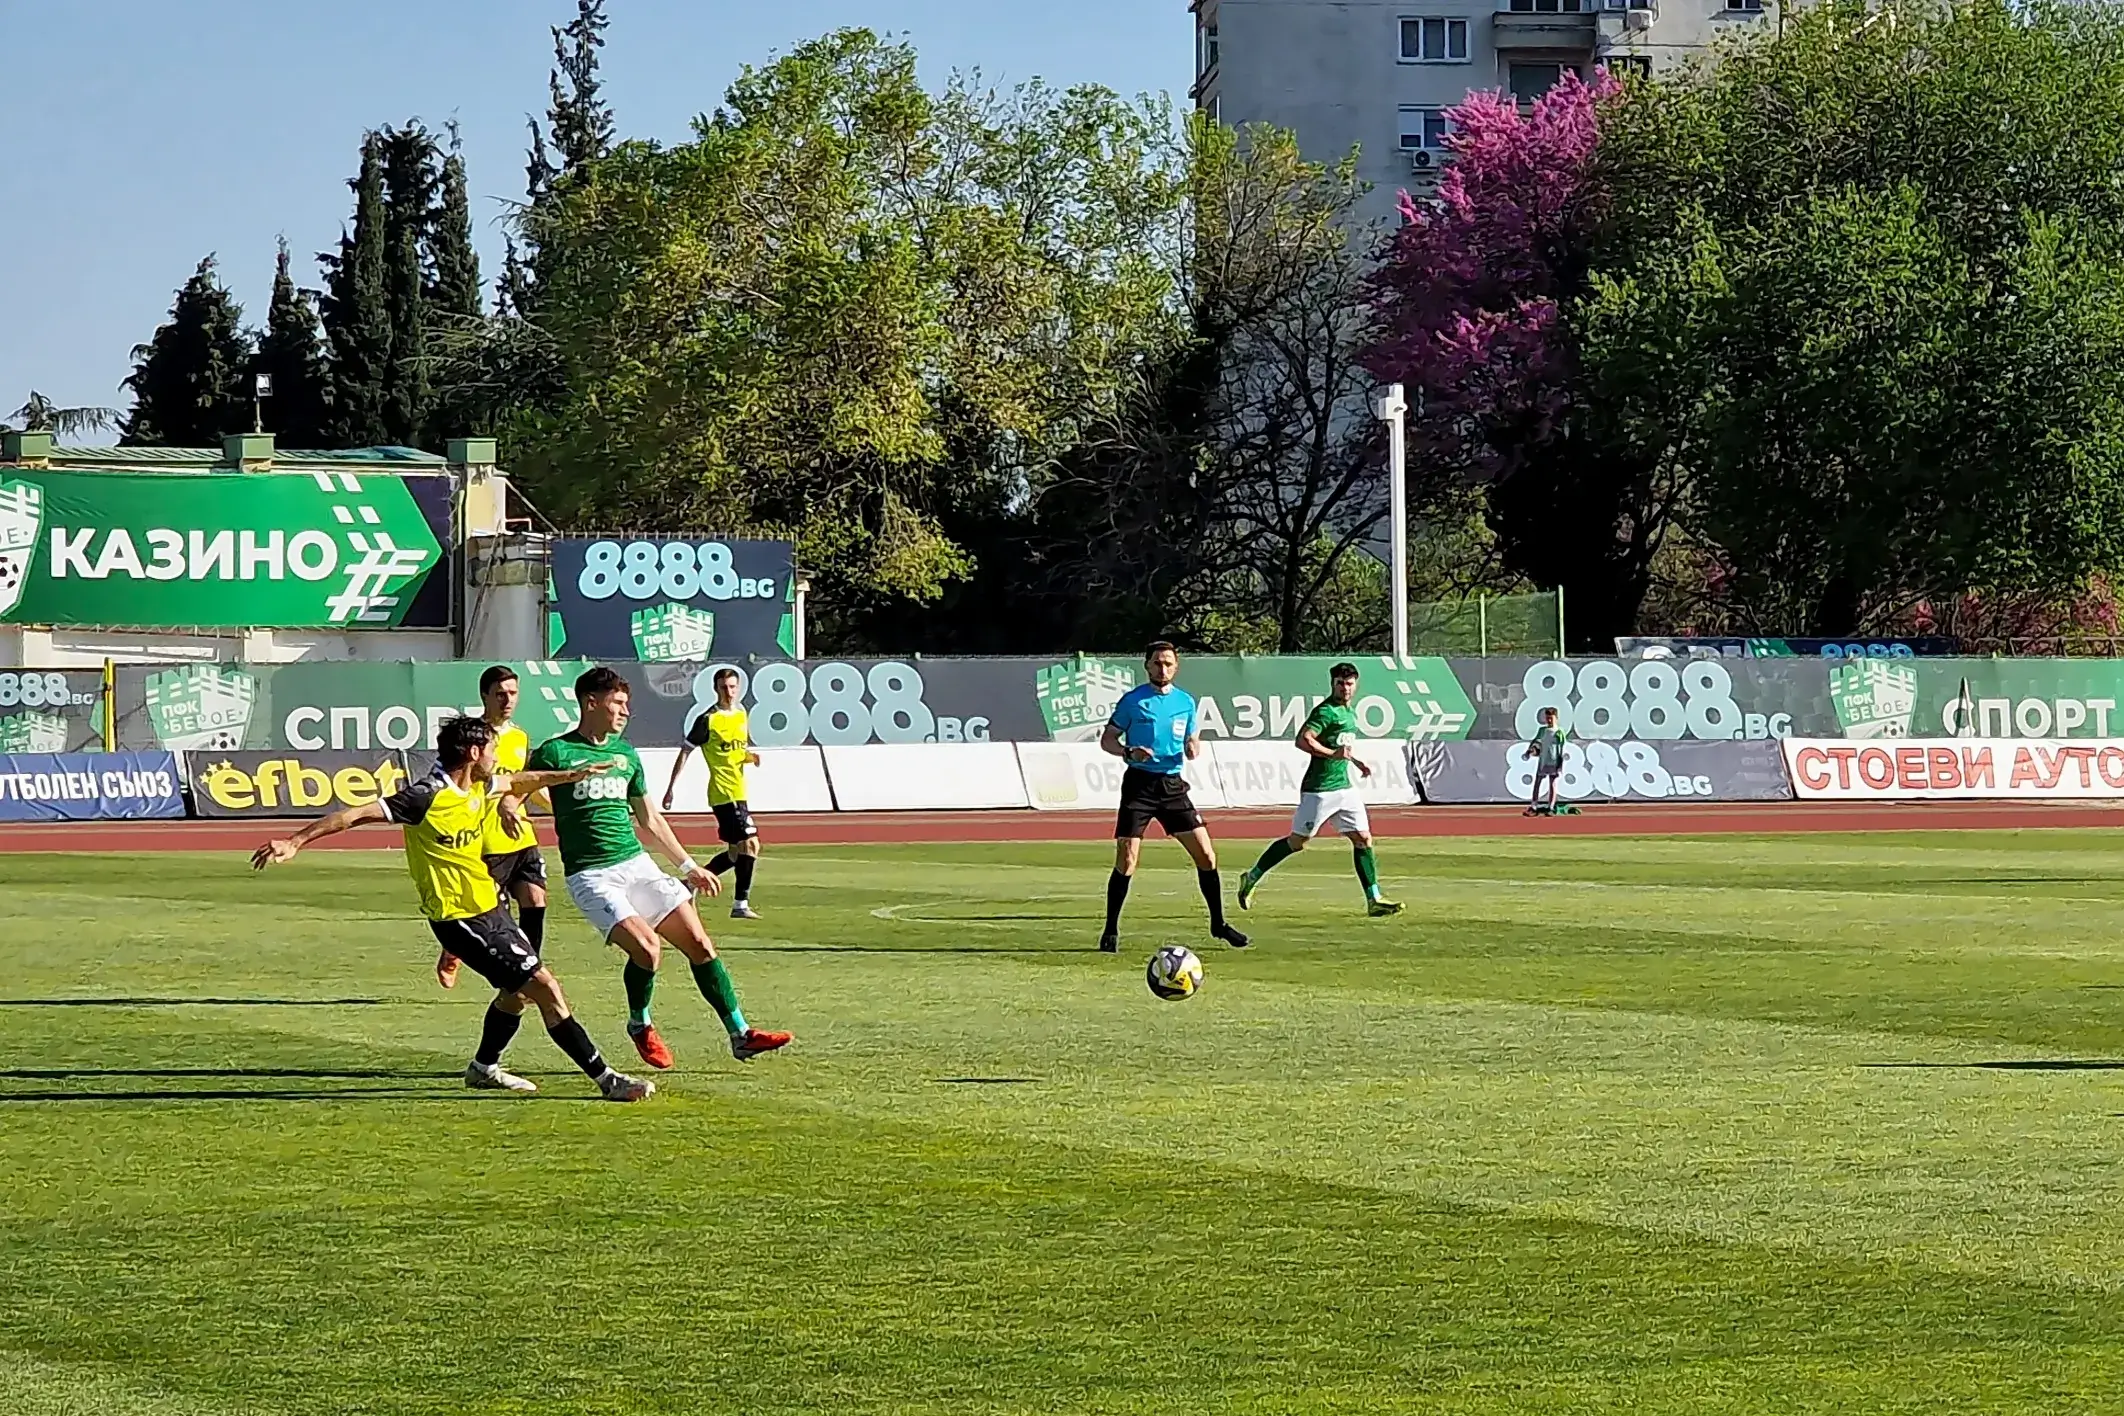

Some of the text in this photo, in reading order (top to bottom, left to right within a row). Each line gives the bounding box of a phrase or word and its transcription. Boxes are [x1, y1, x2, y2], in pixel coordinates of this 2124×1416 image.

[50, 526, 339, 582] КАЗИНО
[578, 541, 776, 600] 8888.BG
[643, 630, 672, 648] ПФК
[161, 700, 200, 719] ПФК
[1051, 692, 1086, 712] ПФК
[1514, 660, 1793, 740] 8888.BG
[1843, 692, 1874, 709] ПФК
[1849, 699, 1904, 721] БЕРОЕ
[169, 708, 237, 733] БЕРОЕ
[1942, 698, 2115, 737] СПОРТ
[1795, 746, 2124, 790] СТОЕВИ АУТО
[0, 771, 174, 801] ТБОЛЕН СЪЮЗ
[209, 759, 404, 809] efbet
